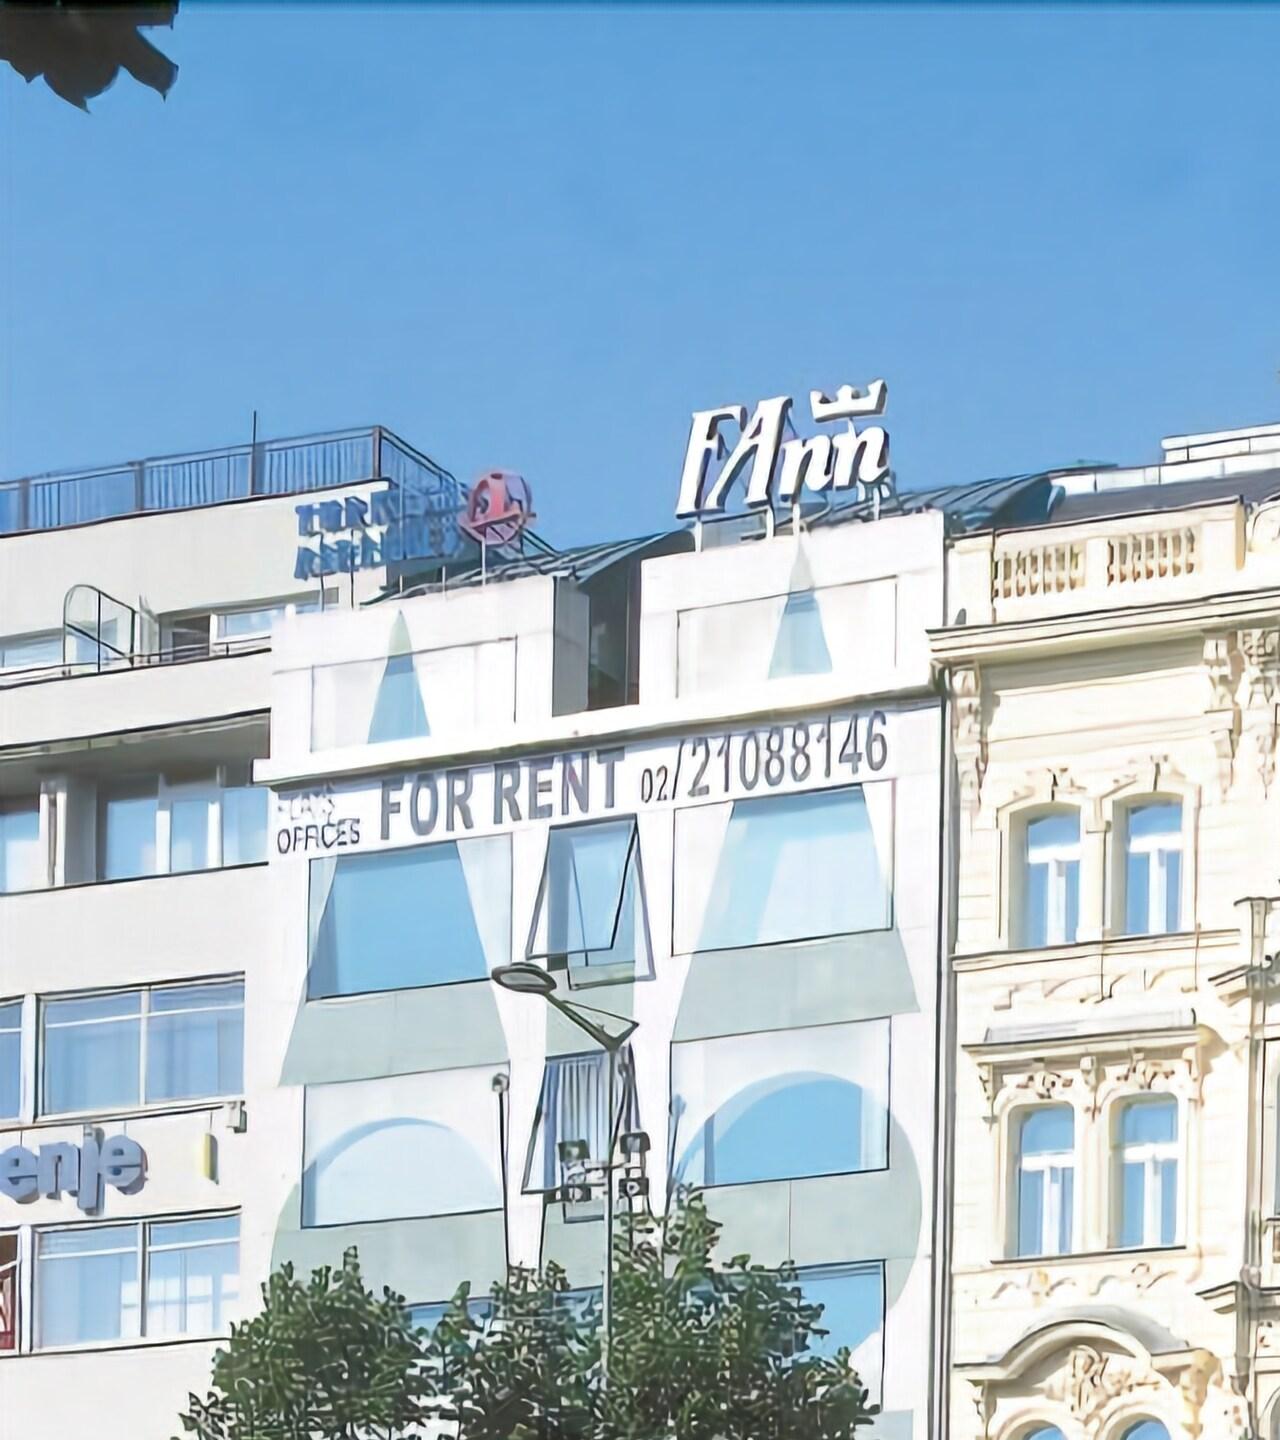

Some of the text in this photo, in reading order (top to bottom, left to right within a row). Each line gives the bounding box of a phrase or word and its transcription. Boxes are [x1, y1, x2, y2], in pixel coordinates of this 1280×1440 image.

[380, 709, 888, 841] FOR RENT 02/21088146
[276, 817, 361, 855] OFFICES
